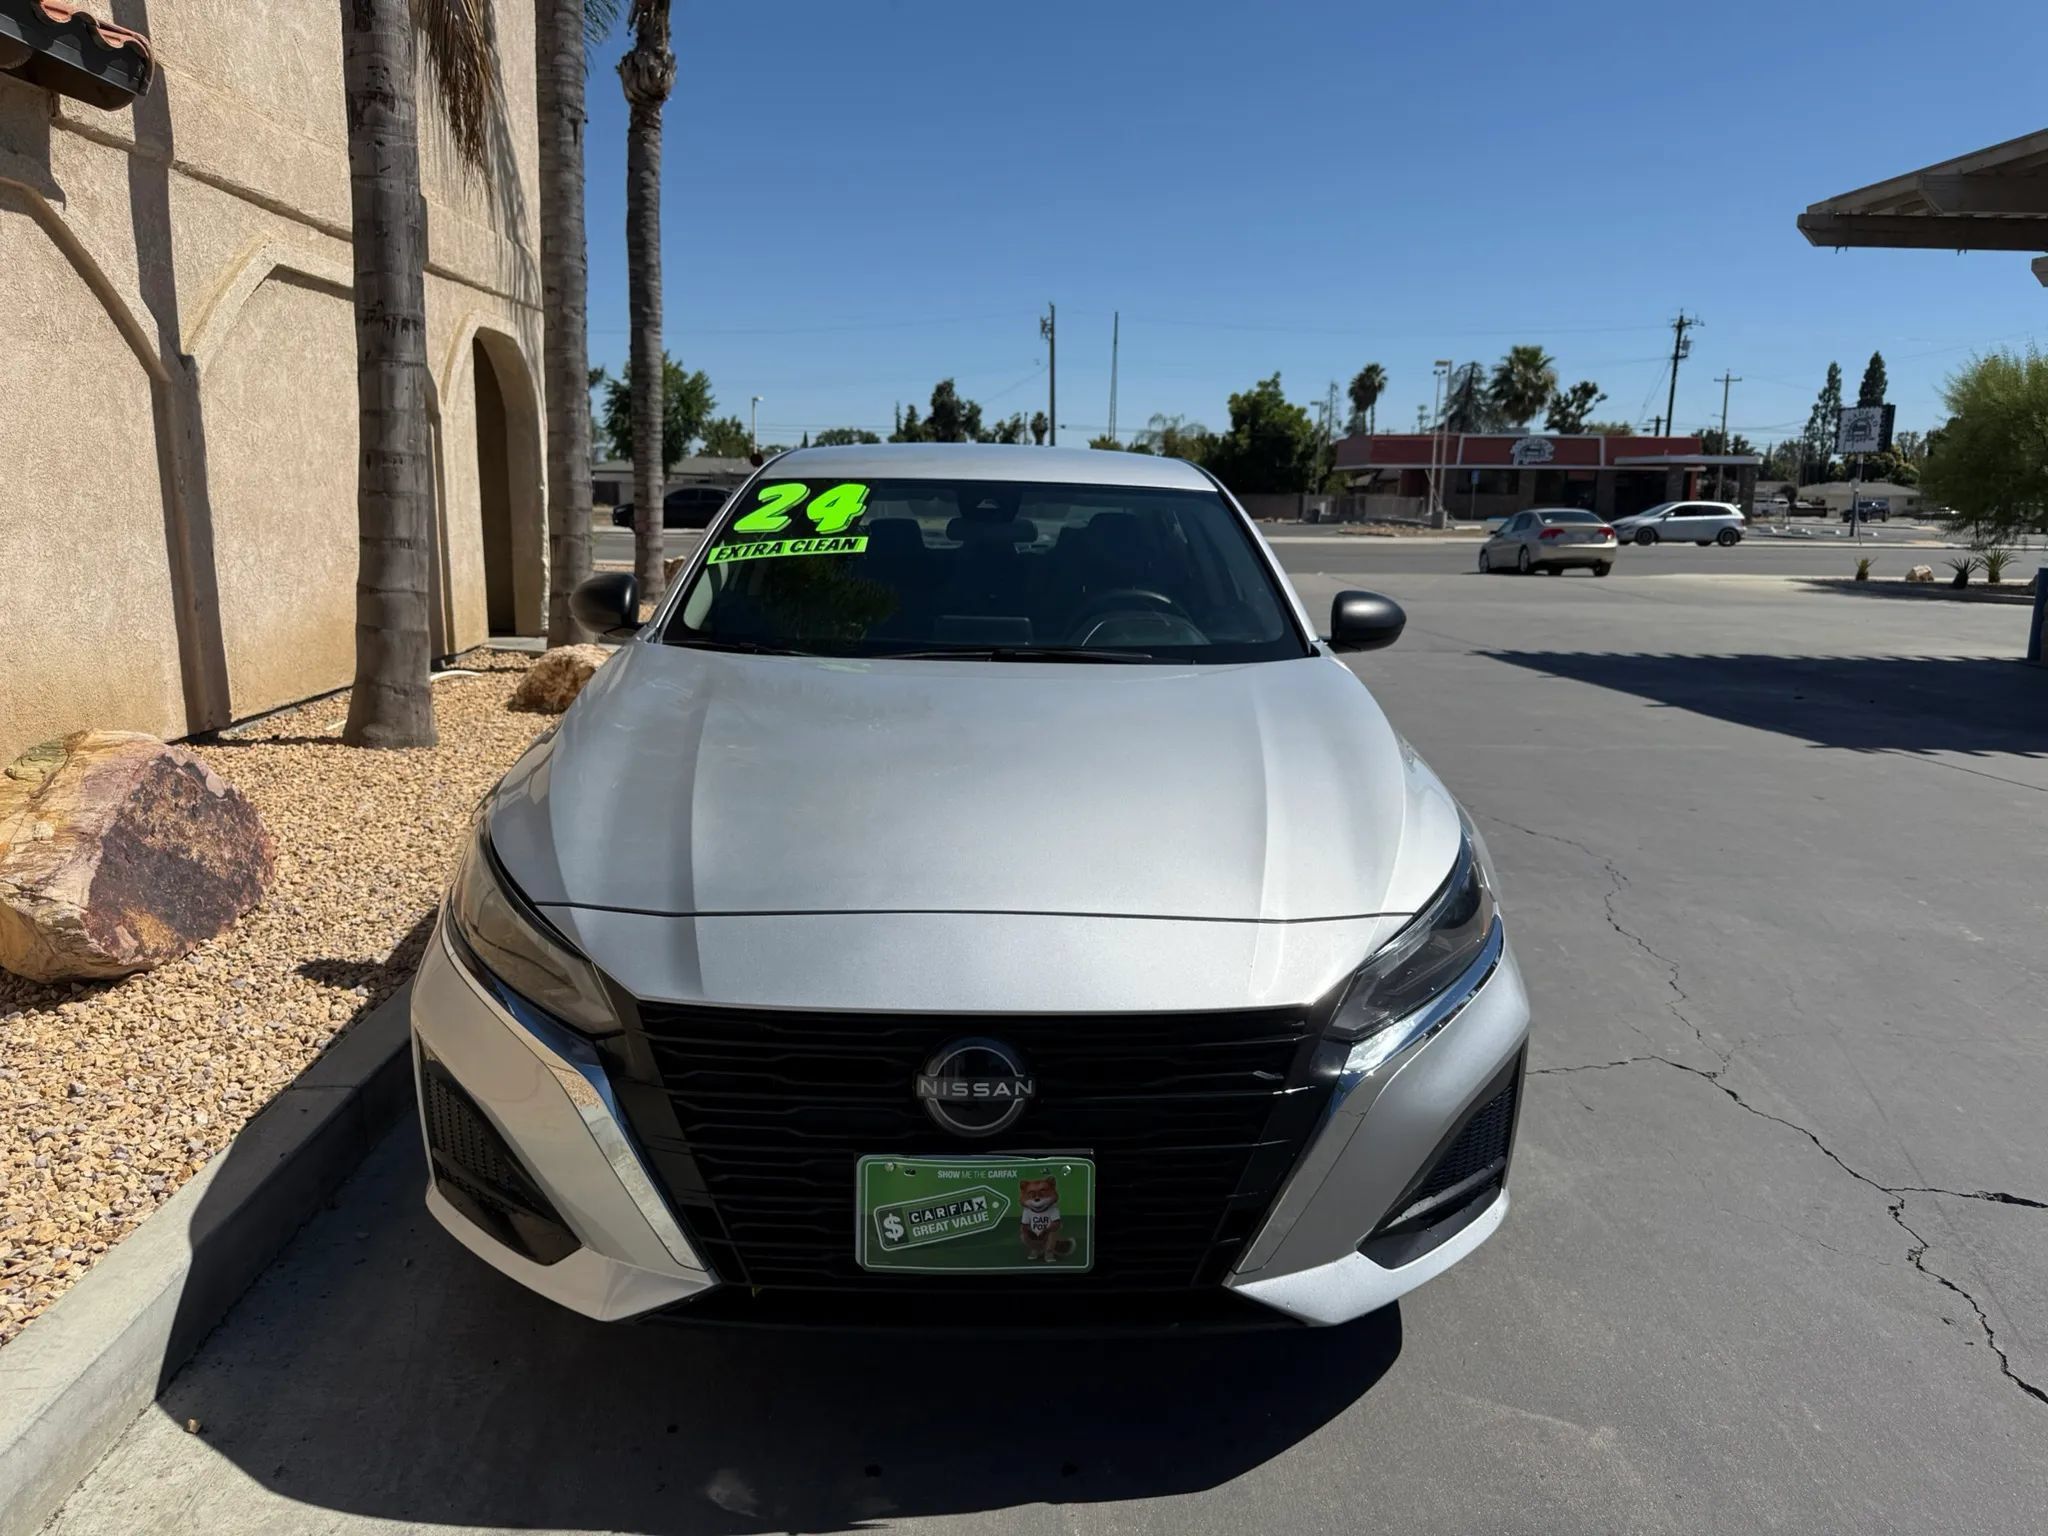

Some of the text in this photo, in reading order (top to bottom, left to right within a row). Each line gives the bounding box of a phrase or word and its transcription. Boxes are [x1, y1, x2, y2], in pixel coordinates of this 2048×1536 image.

[733, 483, 870, 534] 24
[714, 538, 860, 562] EXTRA CLEAN
[920, 1080, 1033, 1097] NISSAN
[937, 1170, 1017, 1179] SHOW ME THE CARFAX
[910, 1197, 986, 1224] CARFAX
[1033, 1216, 1049, 1224] CAR
[912, 1211, 990, 1238] GREAT VALUE
